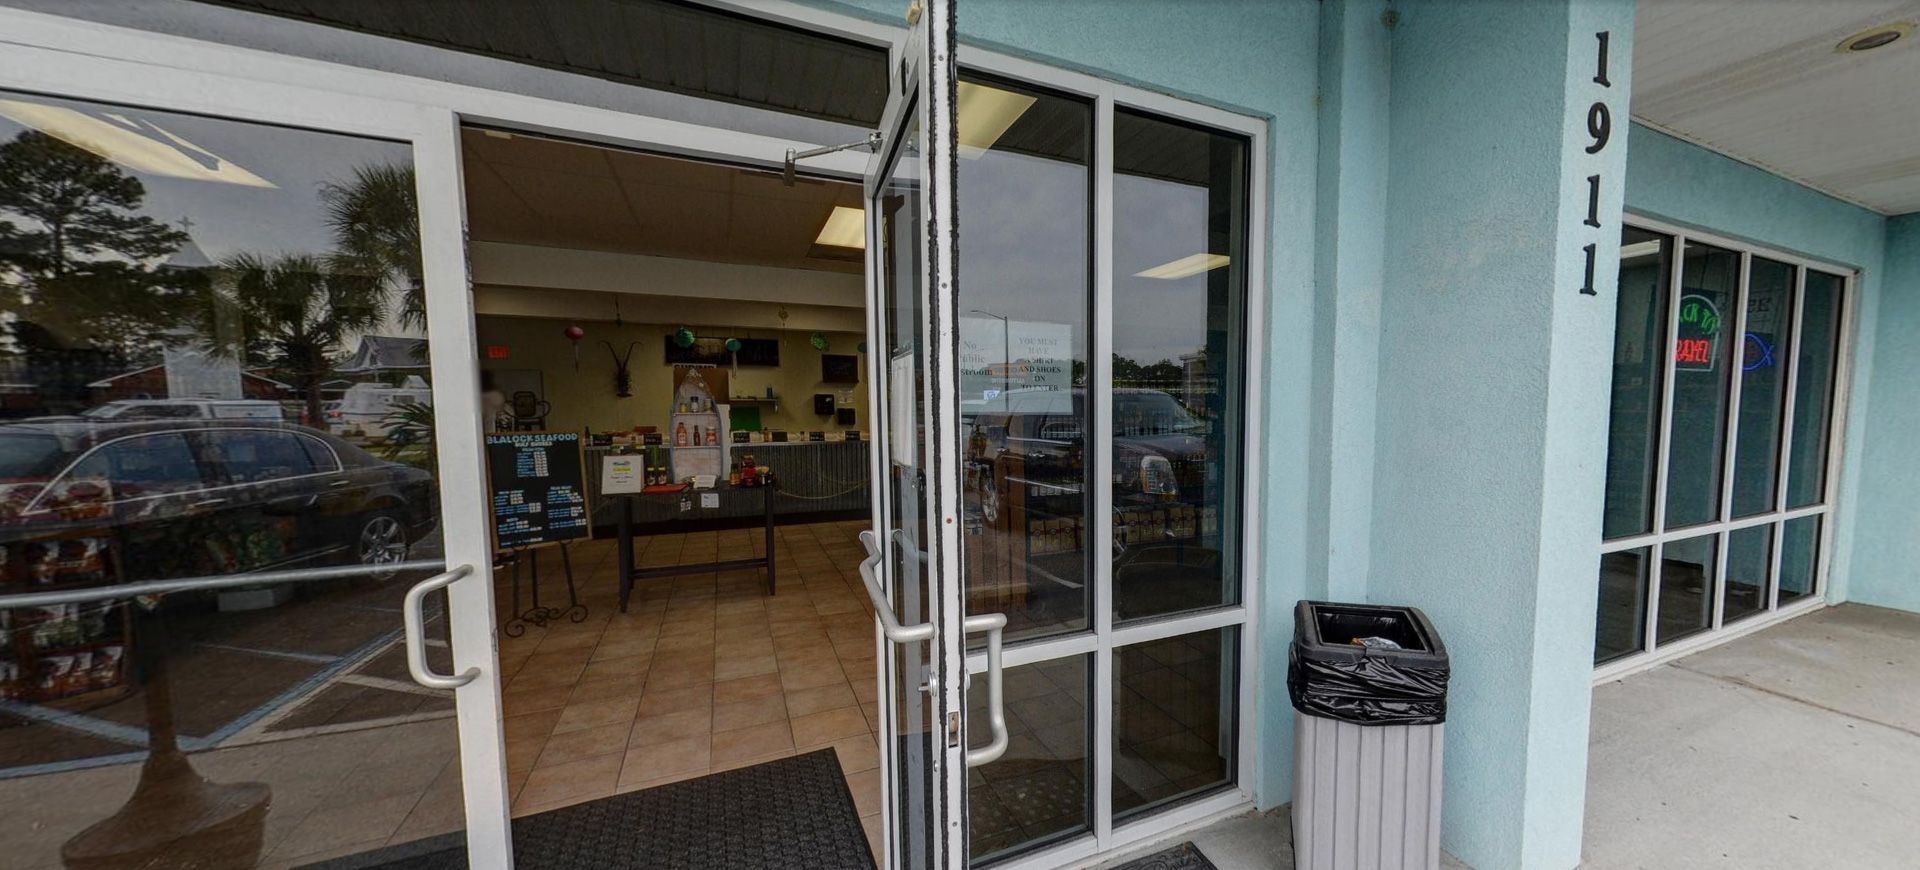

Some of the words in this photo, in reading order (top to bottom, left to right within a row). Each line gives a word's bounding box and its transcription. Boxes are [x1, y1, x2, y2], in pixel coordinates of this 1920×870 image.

[1579, 30, 1611, 296] 1911
[959, 353, 985, 363] ublic
[960, 368, 993, 376] stroom
[1019, 364, 1035, 373] AND
[487, 435, 534, 444] BLALOCK
[534, 433, 578, 442] SEAFOOD
